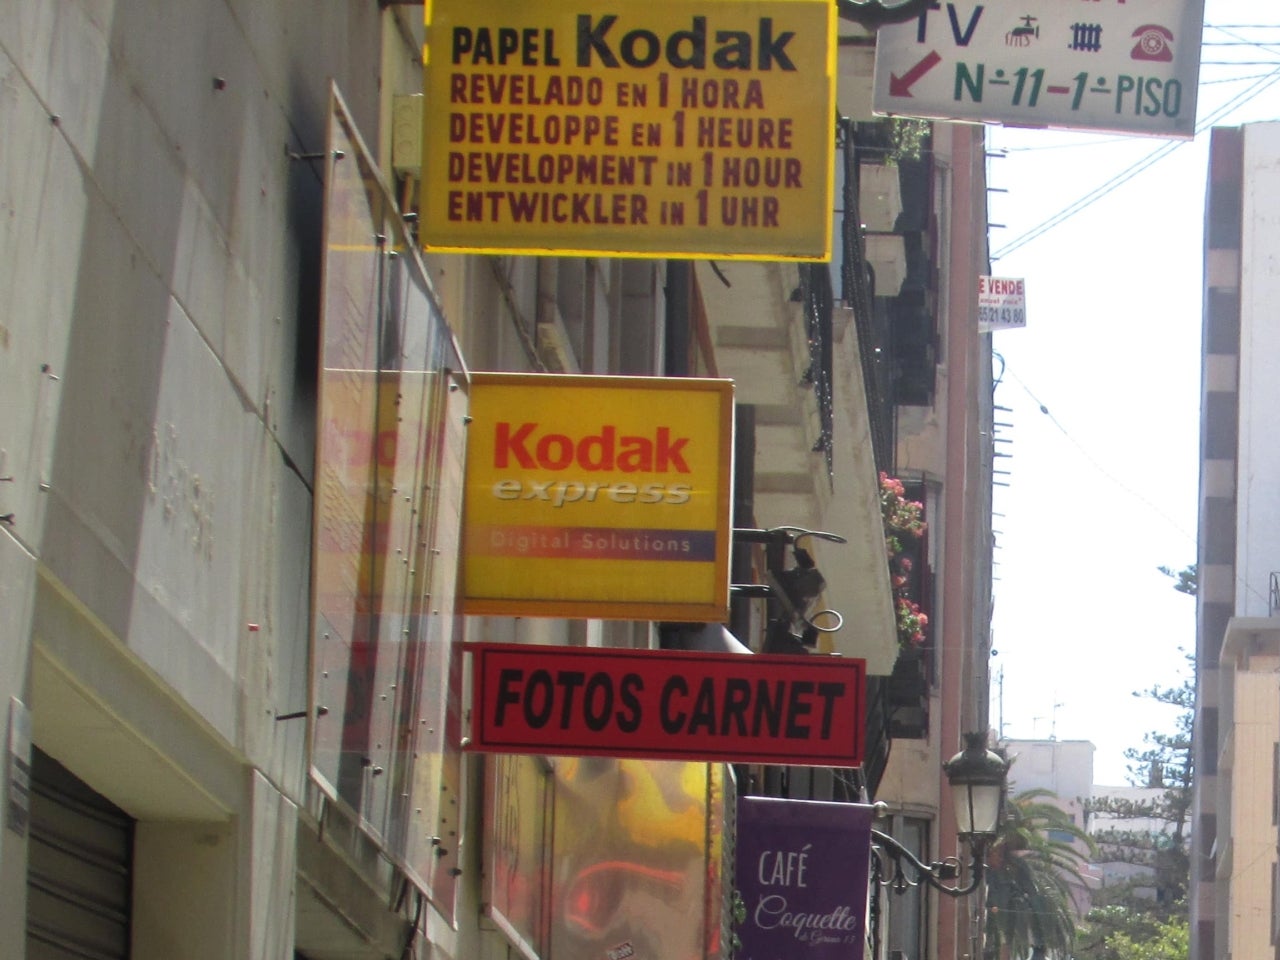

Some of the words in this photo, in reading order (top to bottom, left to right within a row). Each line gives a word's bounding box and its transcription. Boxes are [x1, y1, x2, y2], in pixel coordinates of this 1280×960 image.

[452, 26, 560, 66] PAPEL
[576, 13, 797, 72] Kodak
[450, 73, 604, 105] REVELADO
[617, 82, 647, 107] EN
[658, 72, 669, 108] 1
[681, 77, 764, 110] HORA
[449, 112, 619, 146] DEVELOPPE
[632, 122, 661, 147] EN
[673, 111, 684, 148] 1
[698, 117, 793, 149] HEURE
[448, 152, 658, 186] DEVELOPMENT
[667, 161, 691, 187] IN
[702, 152, 713, 188] 1
[723, 157, 802, 188] HOUR
[448, 191, 648, 225] ENTWICKLER
[660, 200, 684, 226] IN
[696, 190, 708, 227] 1
[721, 196, 779, 228] UHR
[978, 278, 985, 293] E
[988, 279, 1023, 295] VENDE
[494, 421, 692, 474] Kodak
[492, 478, 693, 508] express
[491, 530, 569, 552] Digital
[582, 533, 691, 553] Solutions
[494, 668, 644, 733] FOTOS
[660, 674, 845, 740] CARNET
[759, 844, 812, 888] CAFÉ
[755, 895, 856, 938] Coquette
